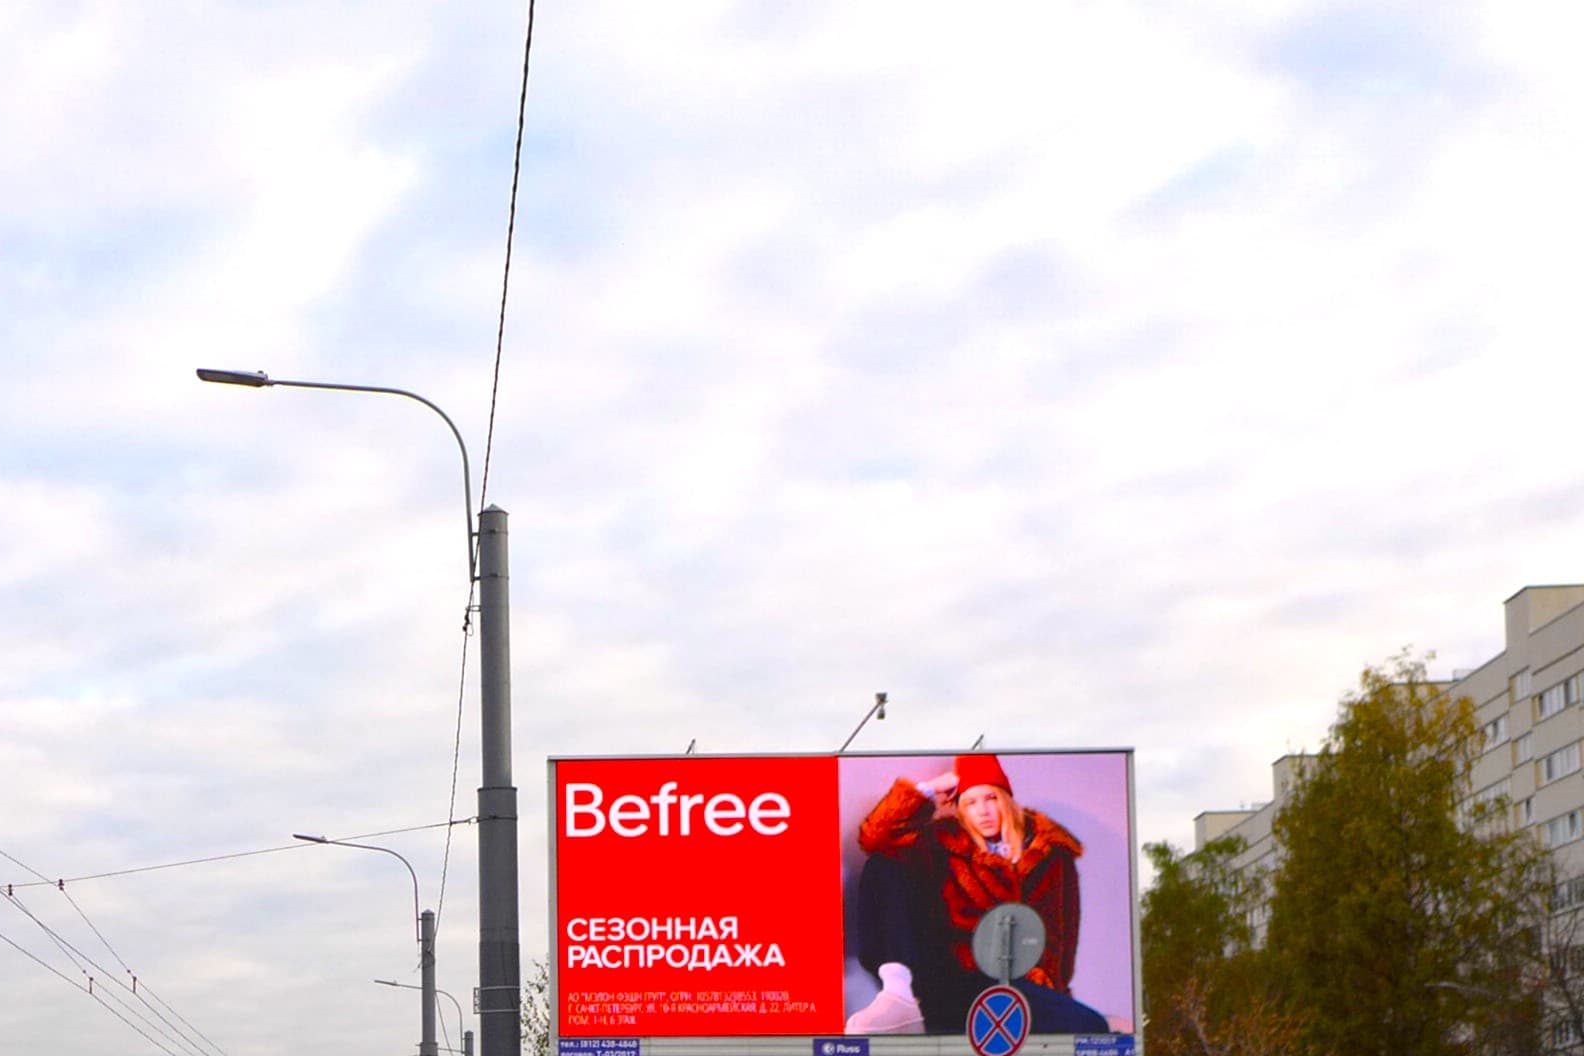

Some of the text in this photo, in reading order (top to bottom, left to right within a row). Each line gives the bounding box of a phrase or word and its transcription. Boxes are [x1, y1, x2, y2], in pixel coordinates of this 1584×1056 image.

[565, 781, 791, 837] Befree
[567, 917, 738, 941] СЕЗОННАЯ
[567, 944, 785, 971] РАСПРОДАЖА
[568, 992, 580, 1002] АО
